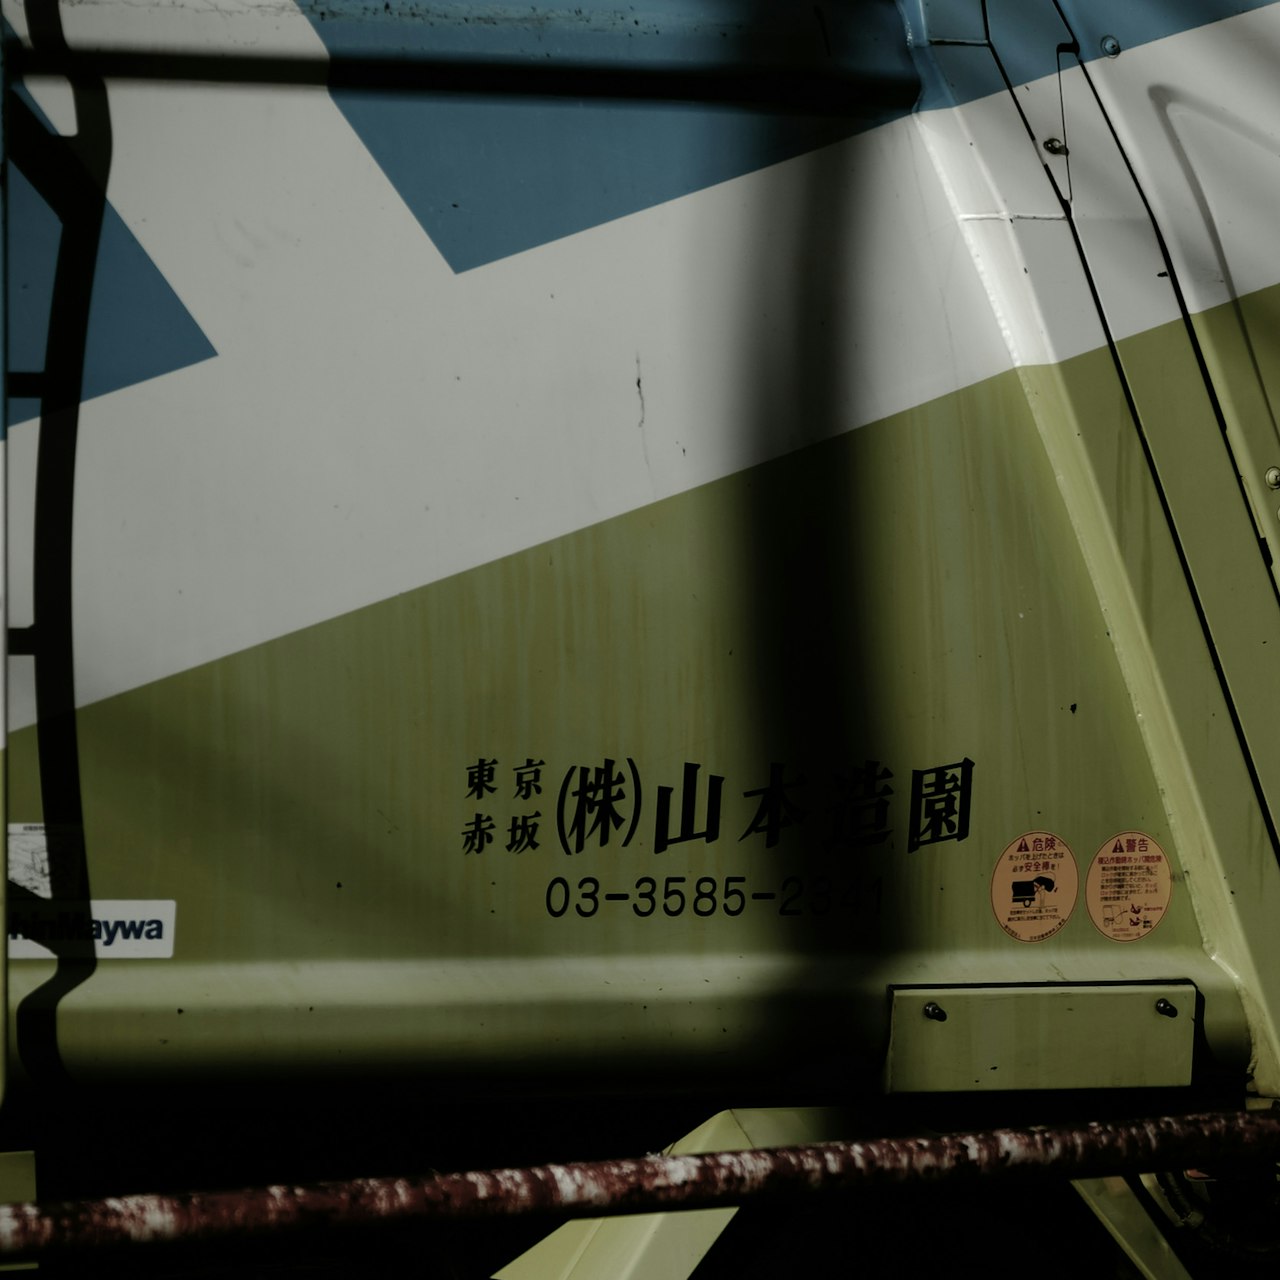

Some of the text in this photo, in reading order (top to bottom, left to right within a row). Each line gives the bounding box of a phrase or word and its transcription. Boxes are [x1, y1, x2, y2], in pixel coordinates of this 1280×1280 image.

[465, 758, 546, 800] 東京
[461, 812, 540, 855] 赤坂
[1032, 838, 1056, 852] 危険
[1125, 838, 1149, 853] 警告
[546, 875, 883, 918] 03-3585-2341
[9, 911, 164, 947] hinMaywa
